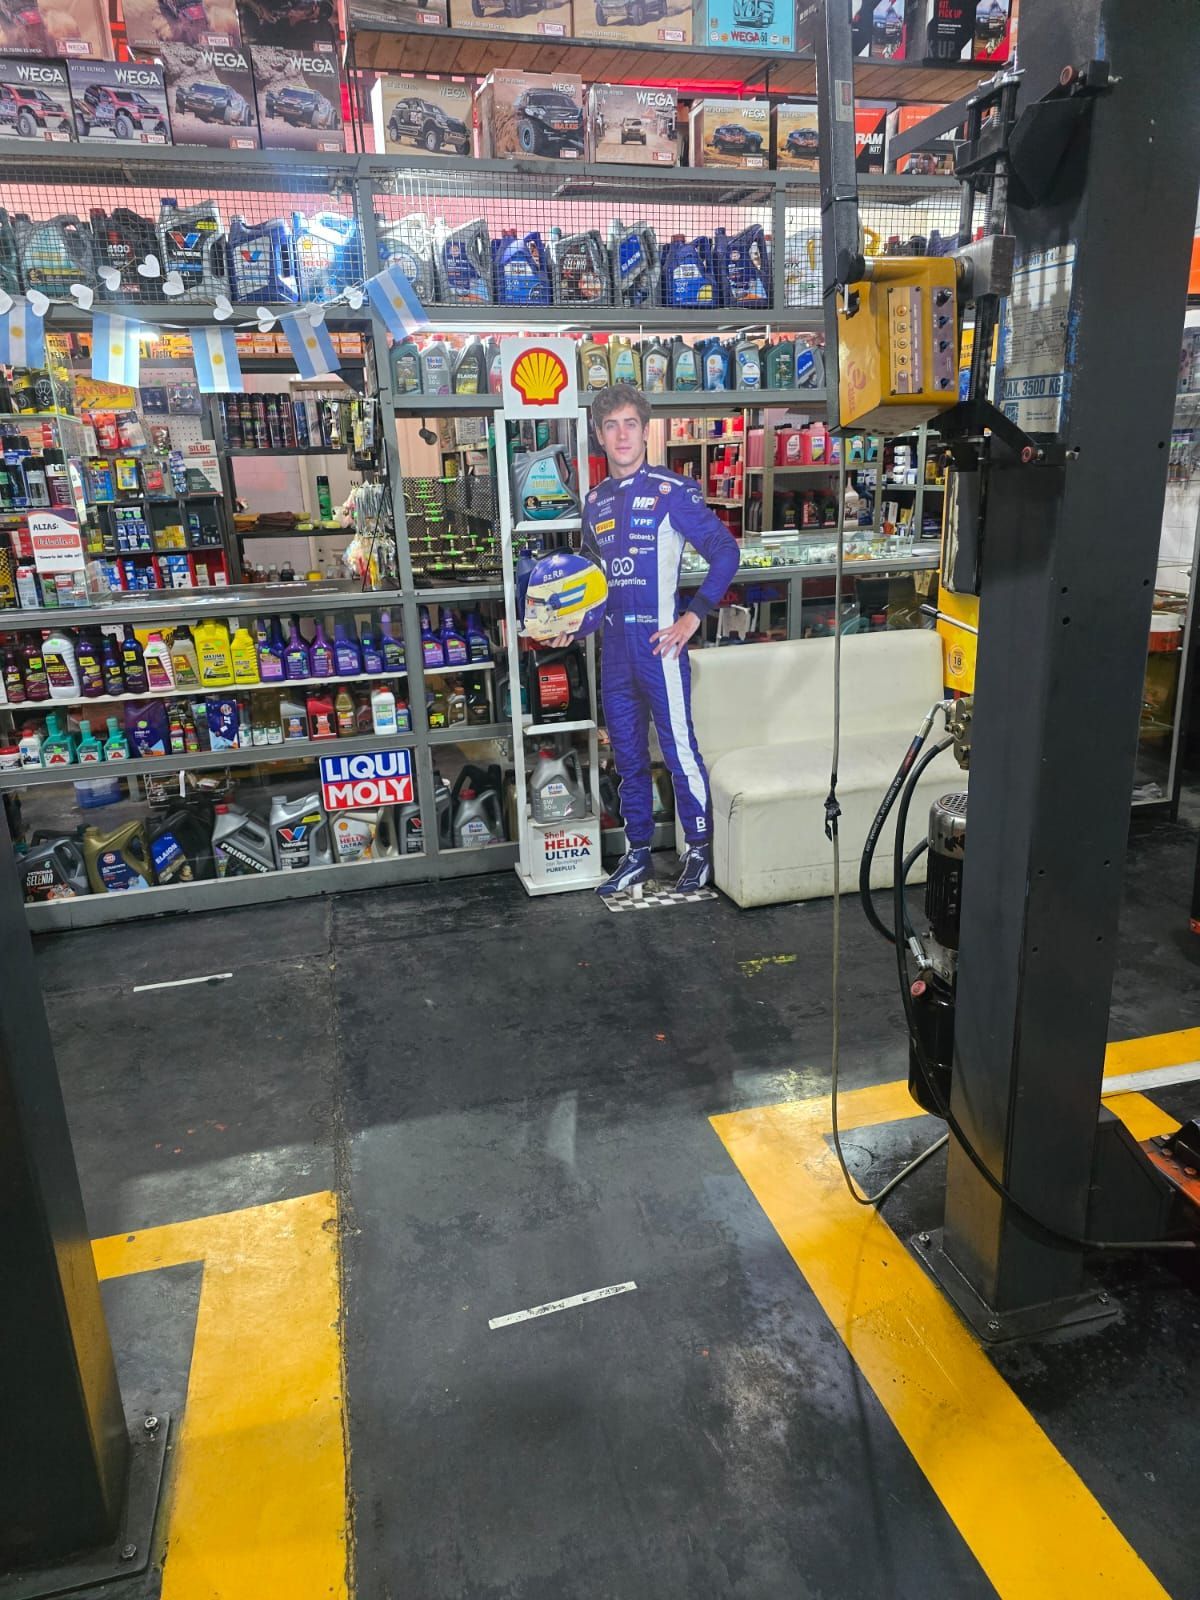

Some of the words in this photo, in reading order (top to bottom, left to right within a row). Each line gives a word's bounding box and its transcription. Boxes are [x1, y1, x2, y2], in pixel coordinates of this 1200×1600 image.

[731, 30, 759, 42] WEGA
[200, 49, 248, 69] WEGA
[290, 56, 335, 74] WEGA
[16, 65, 64, 83] WEGA
[114, 68, 160, 86] WEGA
[552, 81, 576, 94] WEGA
[635, 91, 676, 106] WEGA
[741, 108, 767, 119] WEGA
[855, 133, 884, 145] RAM
[106, 245, 130, 253] 4100
[1022, 378, 1045, 396] 3500
[1048, 377, 1061, 394] KG
[33, 522, 59, 531] ALIAS:
[633, 518, 653, 526] YPF
[954, 656, 962, 666] 18
[325, 752, 407, 783] LIQUI
[328, 776, 410, 809] MOLY
[696, 816, 706, 830] B
[544, 829, 565, 839] Shell
[545, 833, 593, 851] HELIX
[155, 842, 178, 864] ELAION
[221, 842, 269, 873] PRIMATEK
[545, 847, 591, 861] ULTRA
[26, 873, 54, 887] SELENIA
